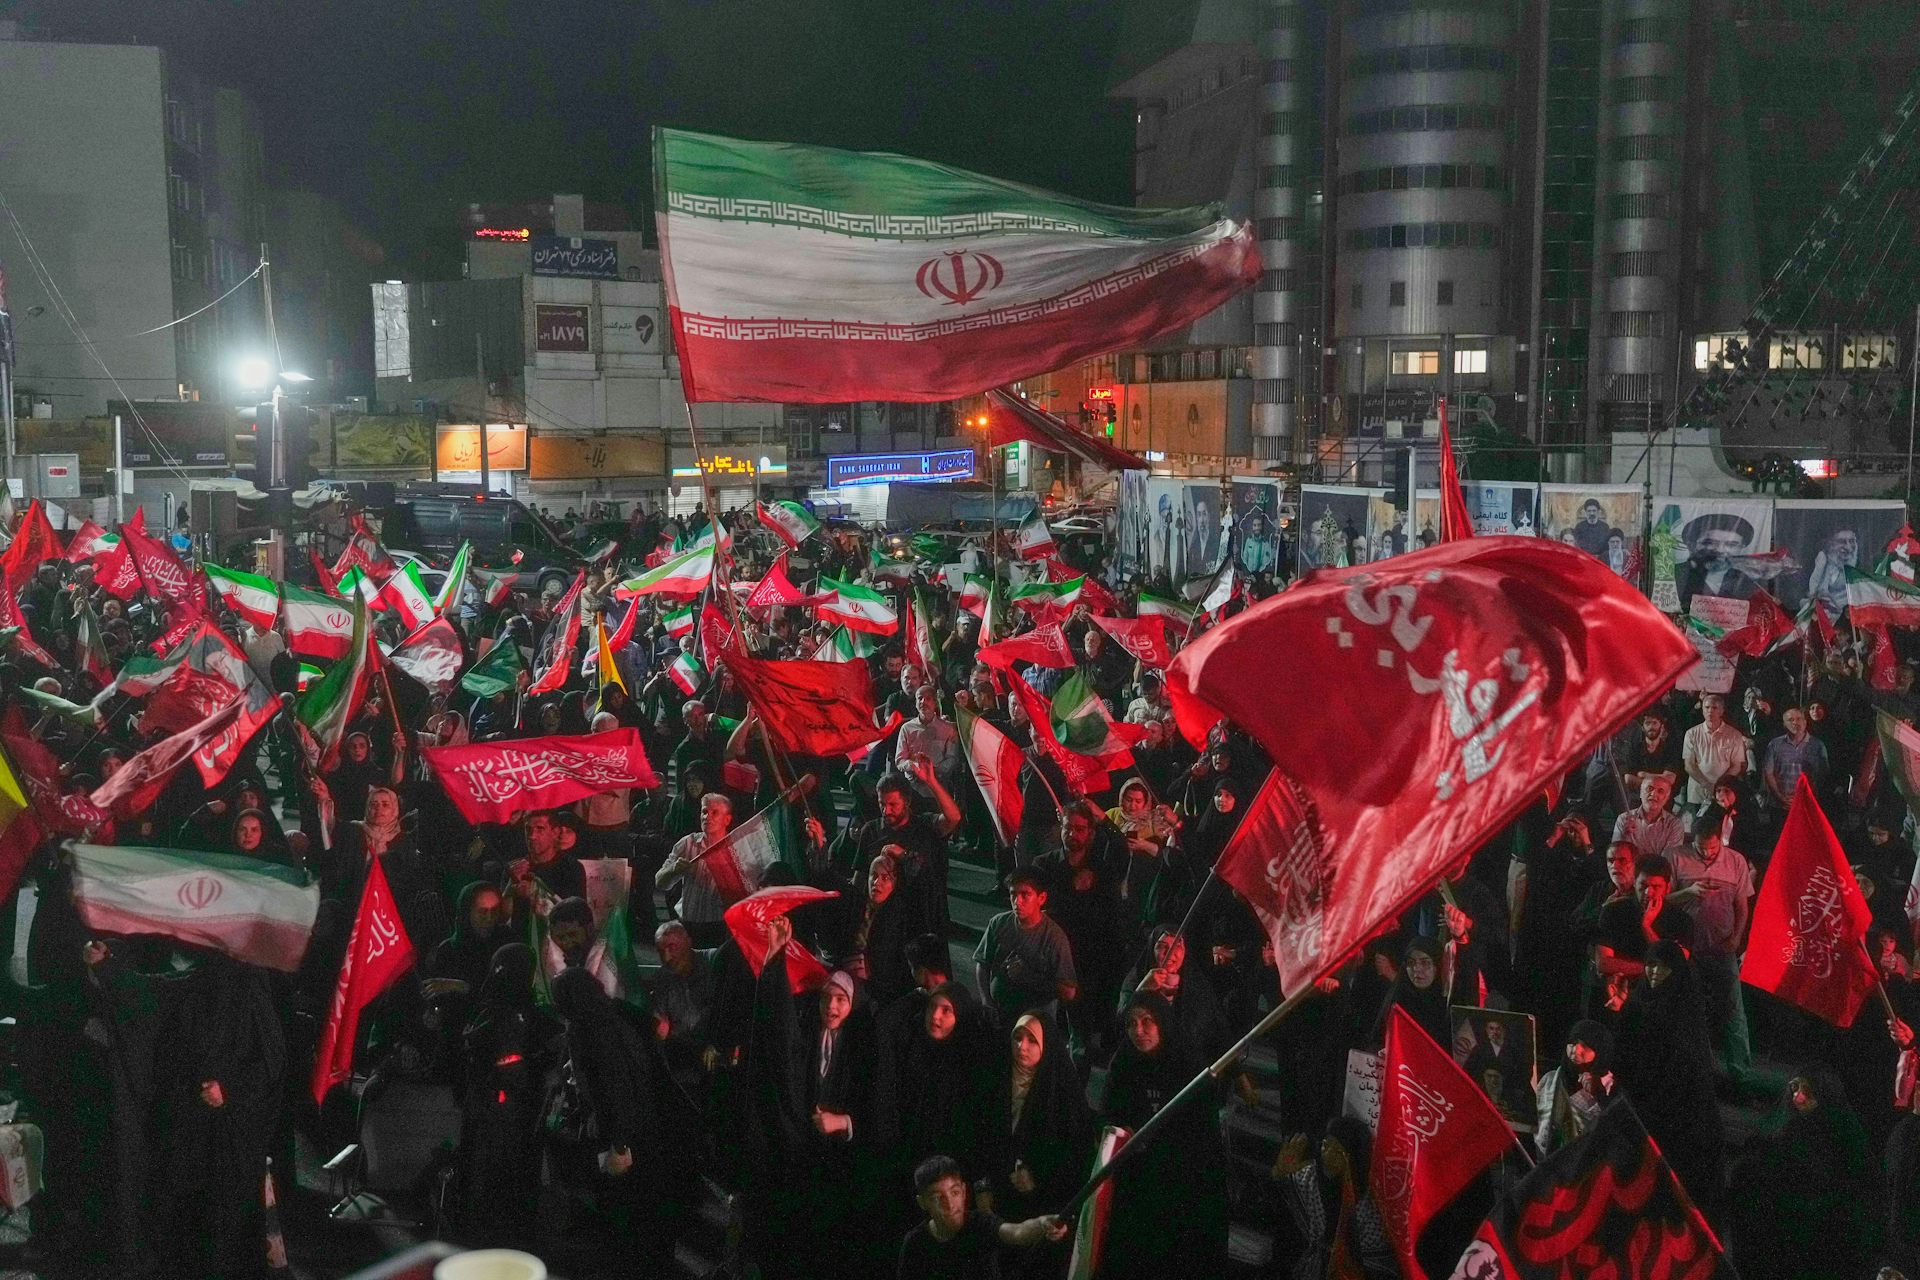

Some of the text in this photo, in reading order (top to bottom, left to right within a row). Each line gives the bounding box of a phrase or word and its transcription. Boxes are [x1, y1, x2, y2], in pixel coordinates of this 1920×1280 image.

[552, 325, 585, 342] ۱۸۷۹
[729, 460, 755, 477] بانک
[839, 466, 856, 474] BANK
[1472, 512, 1508, 521] کلاه ایمنی
[1494, 525, 1508, 534] کلاه
[1435, 687, 1542, 801] یا
